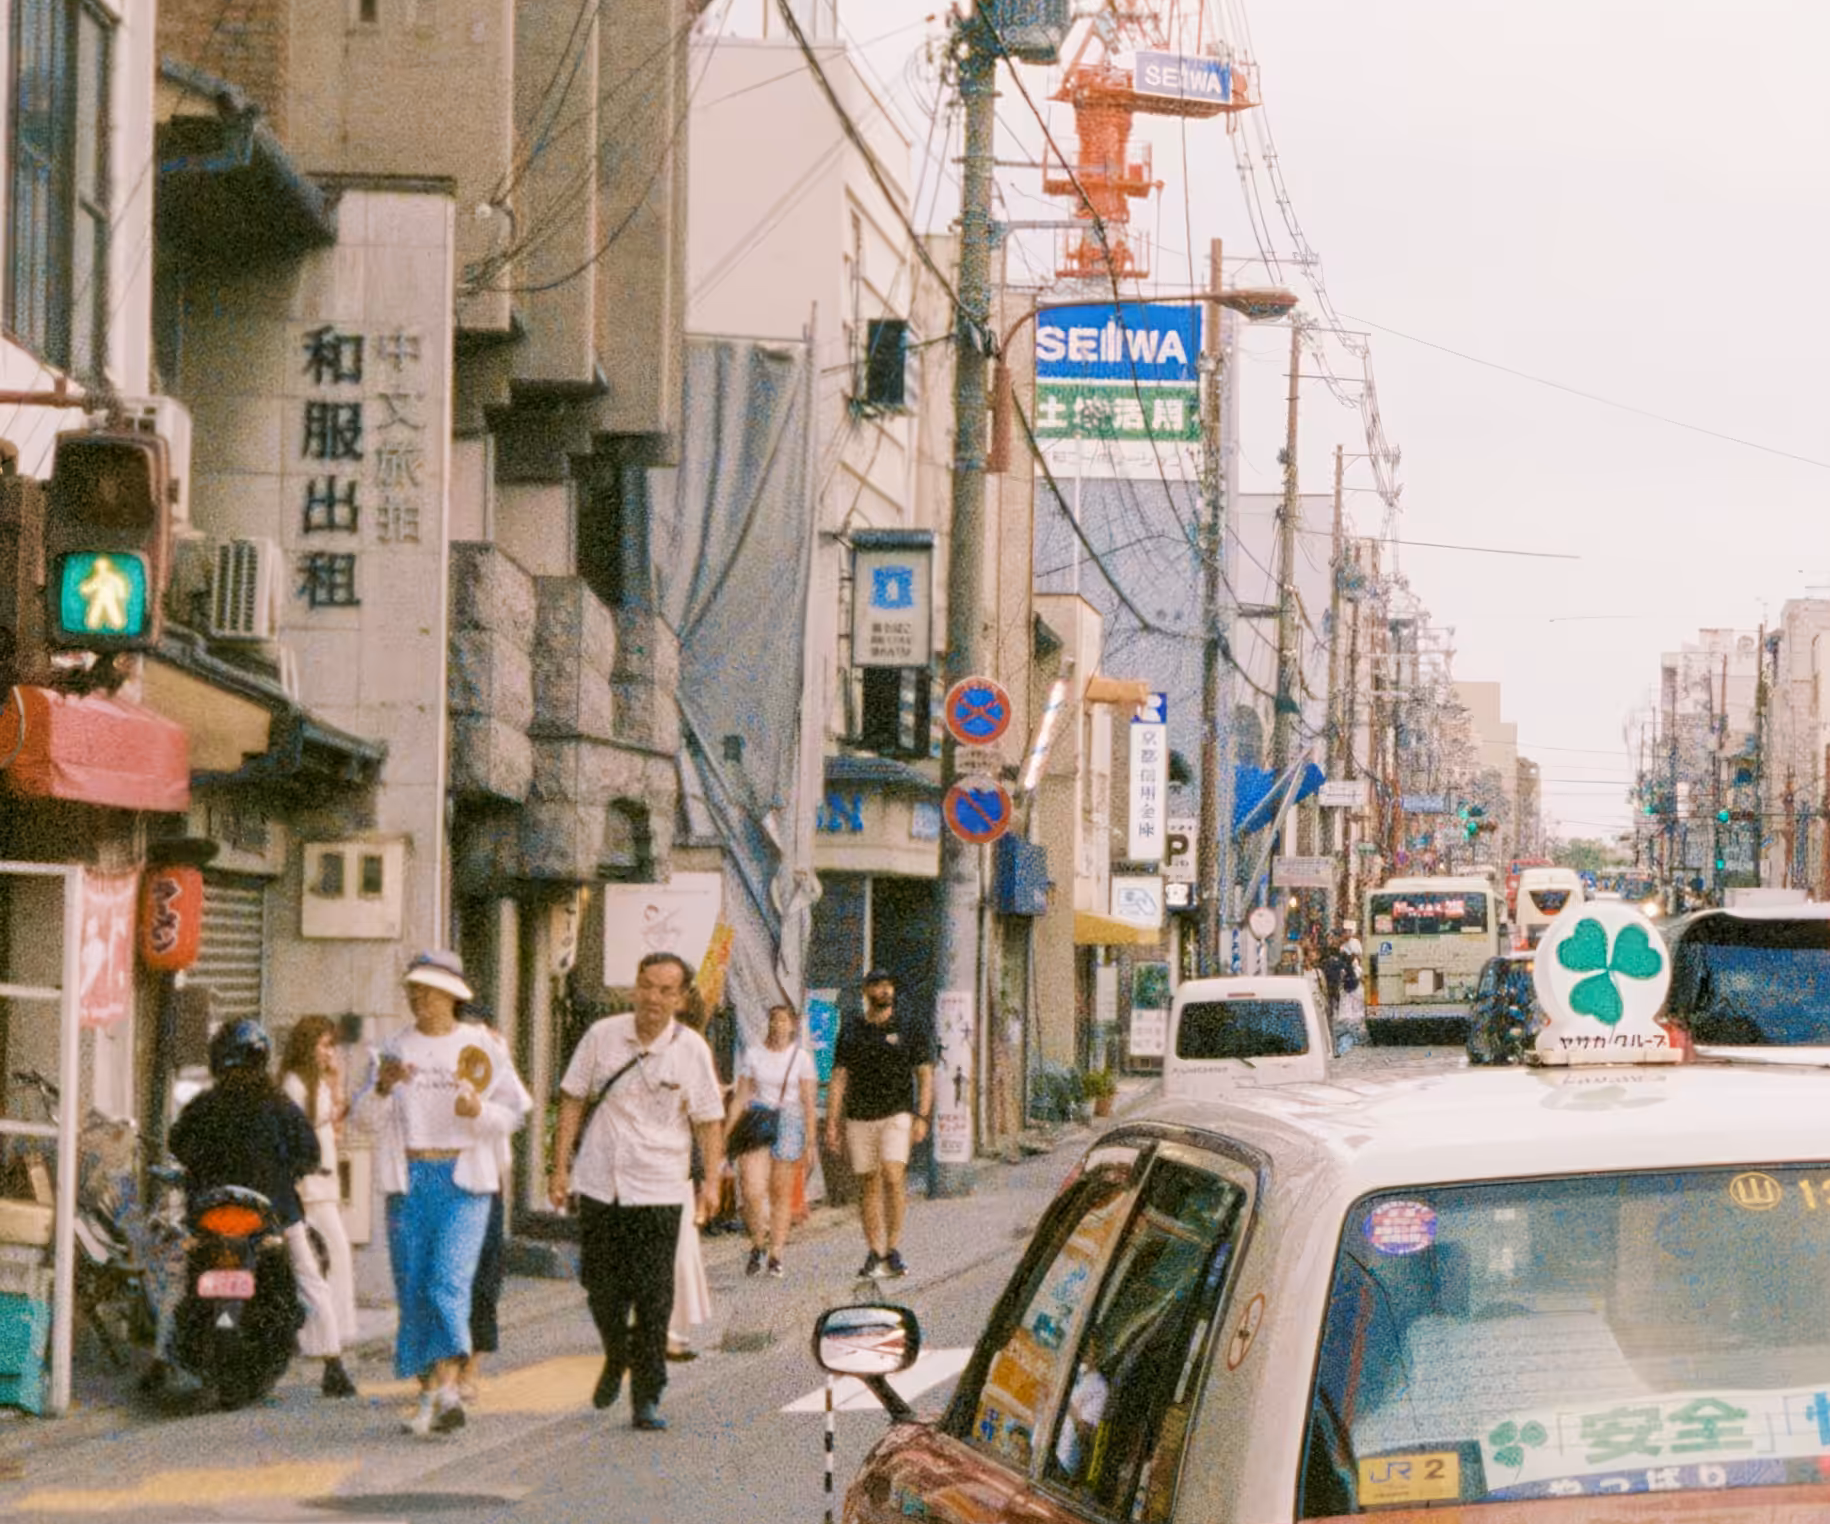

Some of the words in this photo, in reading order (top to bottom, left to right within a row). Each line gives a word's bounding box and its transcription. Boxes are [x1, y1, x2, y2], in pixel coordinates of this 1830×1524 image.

[1145, 64, 1222, 94] SEIWA
[1035, 319, 1188, 364] SEIWA
[298, 325, 363, 608] 和服出租
[1579, 1397, 1753, 1464] 安全
[1424, 1458, 1446, 1480] 2
[1548, 1464, 1728, 1495] やっぱり
